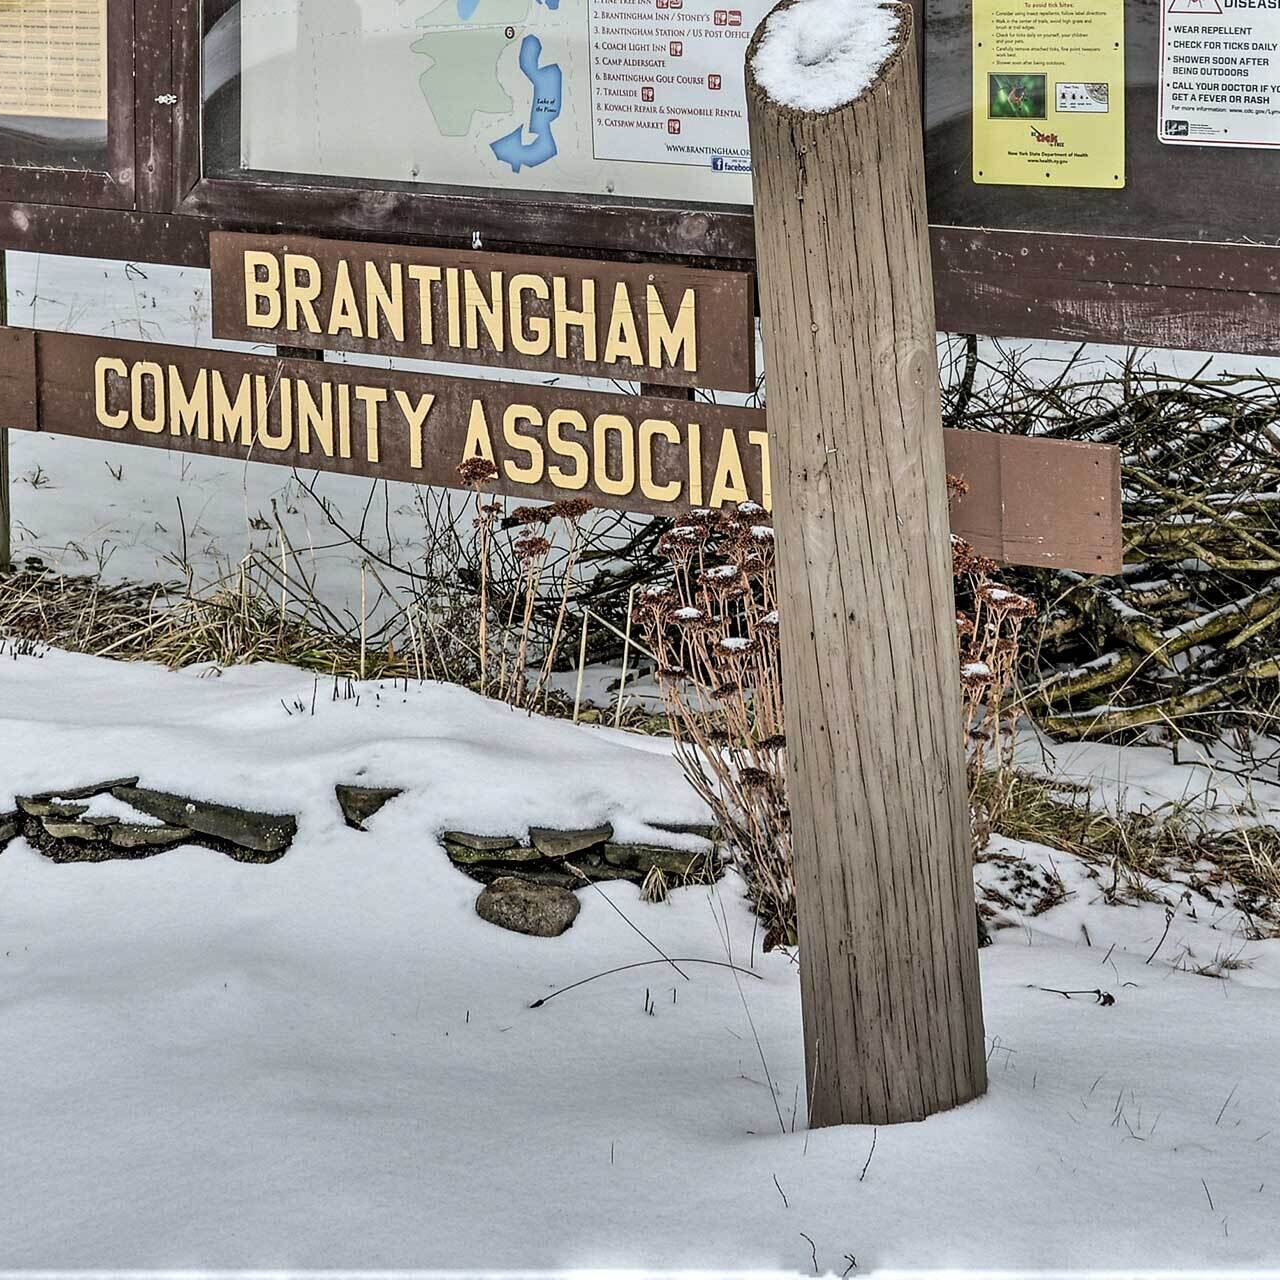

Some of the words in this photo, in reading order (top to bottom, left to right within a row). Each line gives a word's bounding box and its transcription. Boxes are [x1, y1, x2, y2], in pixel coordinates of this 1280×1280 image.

[593, 11, 600, 19] 2.
[593, 26, 600, 35] 3.
[692, 29, 703, 38] US
[1173, 25, 1200, 34] WEAR
[1201, 26, 1253, 36] REPELLENT
[593, 42, 600, 50] 4.
[1173, 40, 1202, 49] CHECK
[1203, 41, 1221, 50] FOR
[1222, 42, 1250, 51] TICKS
[1251, 43, 1278, 51] DAILY
[594, 56, 601, 65] 5.
[1172, 55, 1210, 64] SHOWER
[1211, 56, 1237, 65] SOON
[1239, 57, 1270, 66] AFTER
[595, 72, 602, 81] 6.
[1172, 66, 1199, 75] BEING
[1200, 68, 1249, 77] OUTDOORS
[596, 87, 603, 96] 7.
[1172, 81, 1194, 90] CALL
[1195, 82, 1219, 91] YOUR
[1221, 83, 1258, 93] DOCTOR
[1260, 84, 1269, 93] IF
[1171, 92, 1189, 101] GET
[1190, 93, 1197, 101] A
[1198, 94, 1227, 103] FEVER
[1228, 95, 1242, 103] OR
[1243, 96, 1270, 104] RASH
[596, 103, 603, 111] 8.
[658, 106, 665, 114] &
[597, 118, 604, 127] 9.
[243, 250, 698, 372] BRANTINGHAM
[94, 356, 436, 470] COMMUNITY
[461, 398, 773, 512] ASSOCIAT
